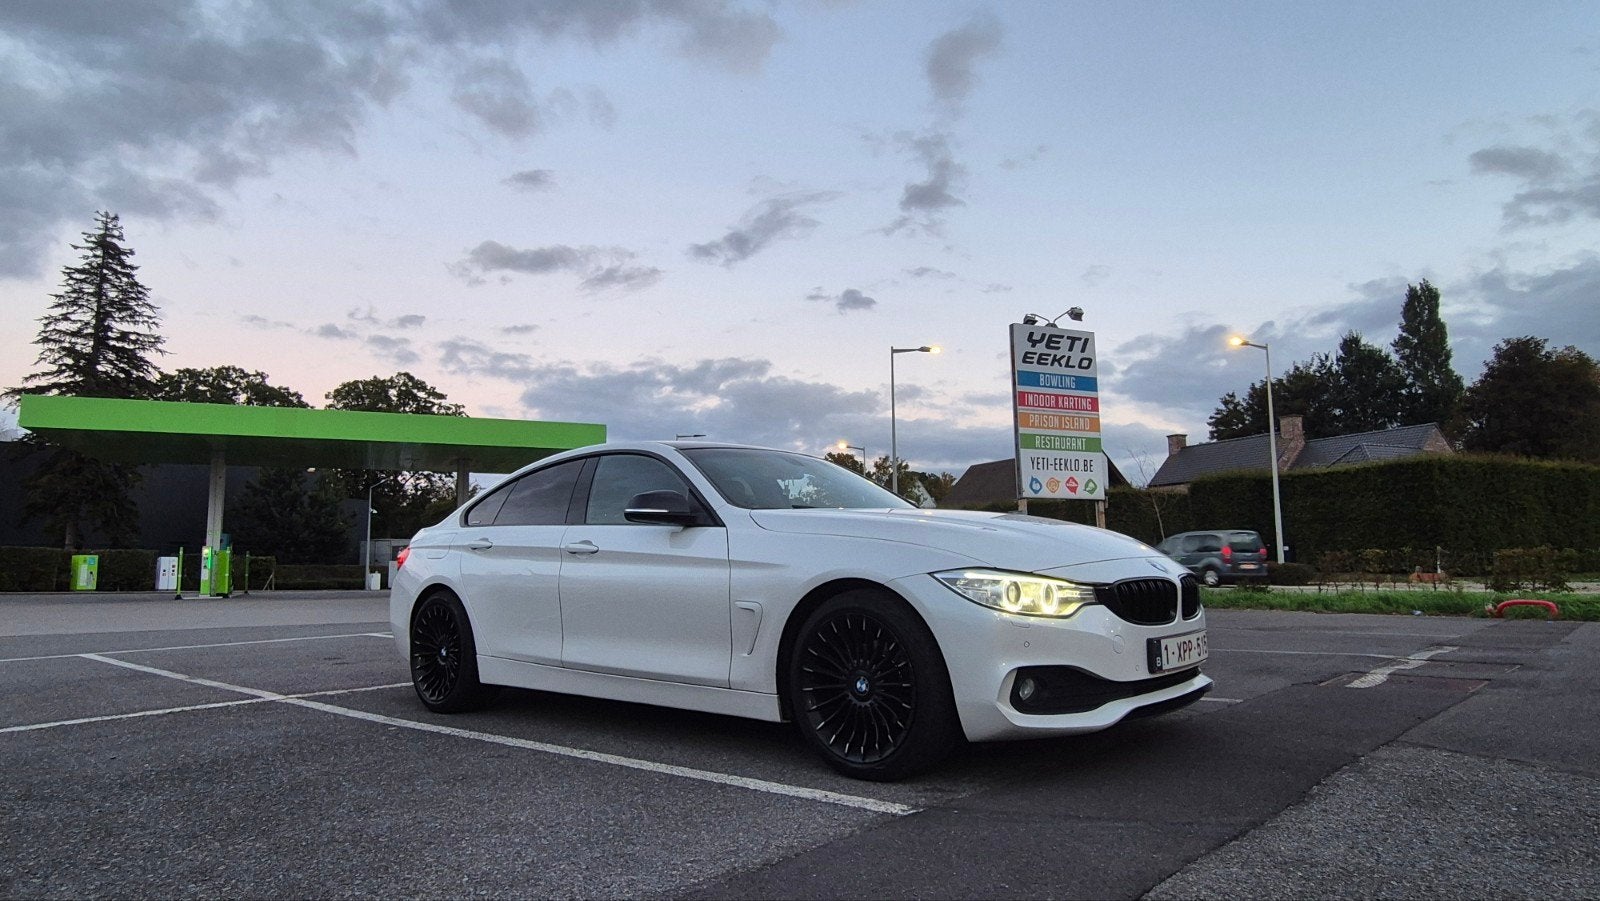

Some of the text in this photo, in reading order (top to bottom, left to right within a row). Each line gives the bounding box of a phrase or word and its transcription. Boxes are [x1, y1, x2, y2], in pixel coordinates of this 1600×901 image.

[1027, 332, 1089, 353] YETI
[1022, 351, 1093, 370] EEKLO
[1040, 374, 1076, 388] BOWLING
[1025, 392, 1092, 410] INDOOR KARTING
[1030, 414, 1090, 430] PRISON ISLAND
[1036, 436, 1086, 450] RESTAURANT
[1030, 456, 1094, 472] YETI-EEKLO.BE
[1156, 656, 1162, 666] B
